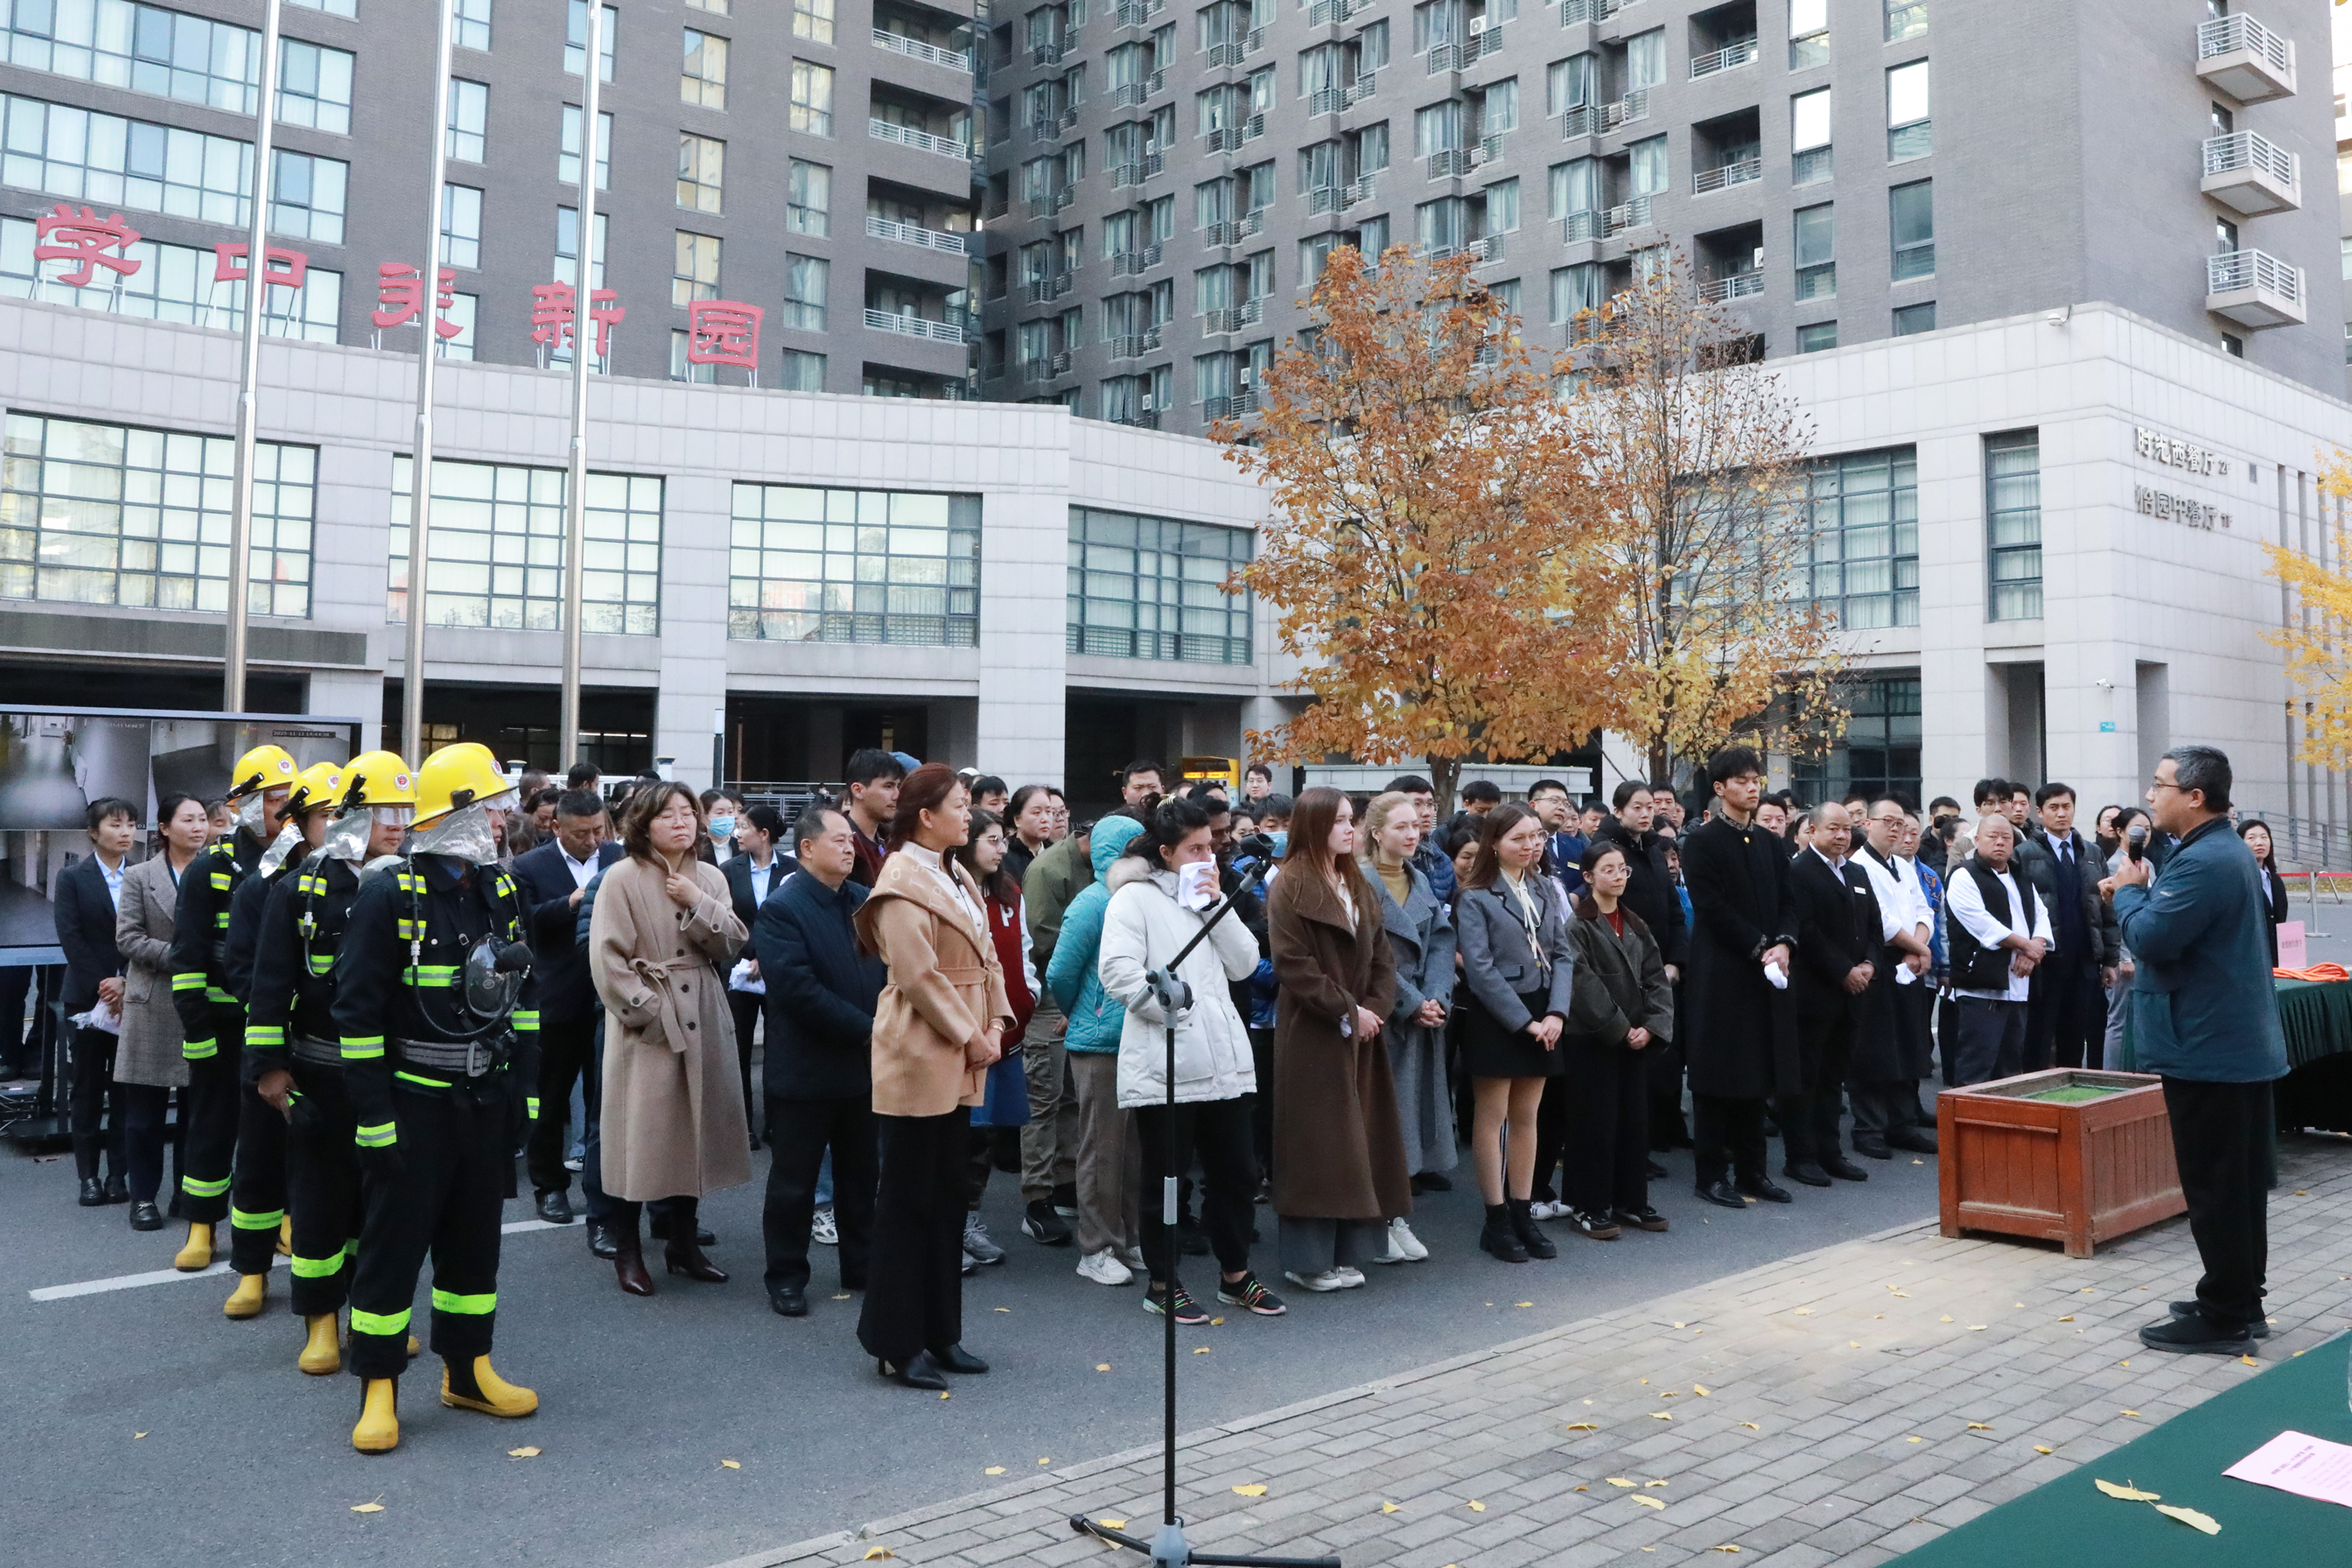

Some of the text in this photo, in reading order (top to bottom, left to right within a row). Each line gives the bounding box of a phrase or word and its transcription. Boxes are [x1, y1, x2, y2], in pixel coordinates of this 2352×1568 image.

[2134, 426, 2216, 476] 时光西餐厅
[2134, 484, 2218, 531] 怡园中餐厅
